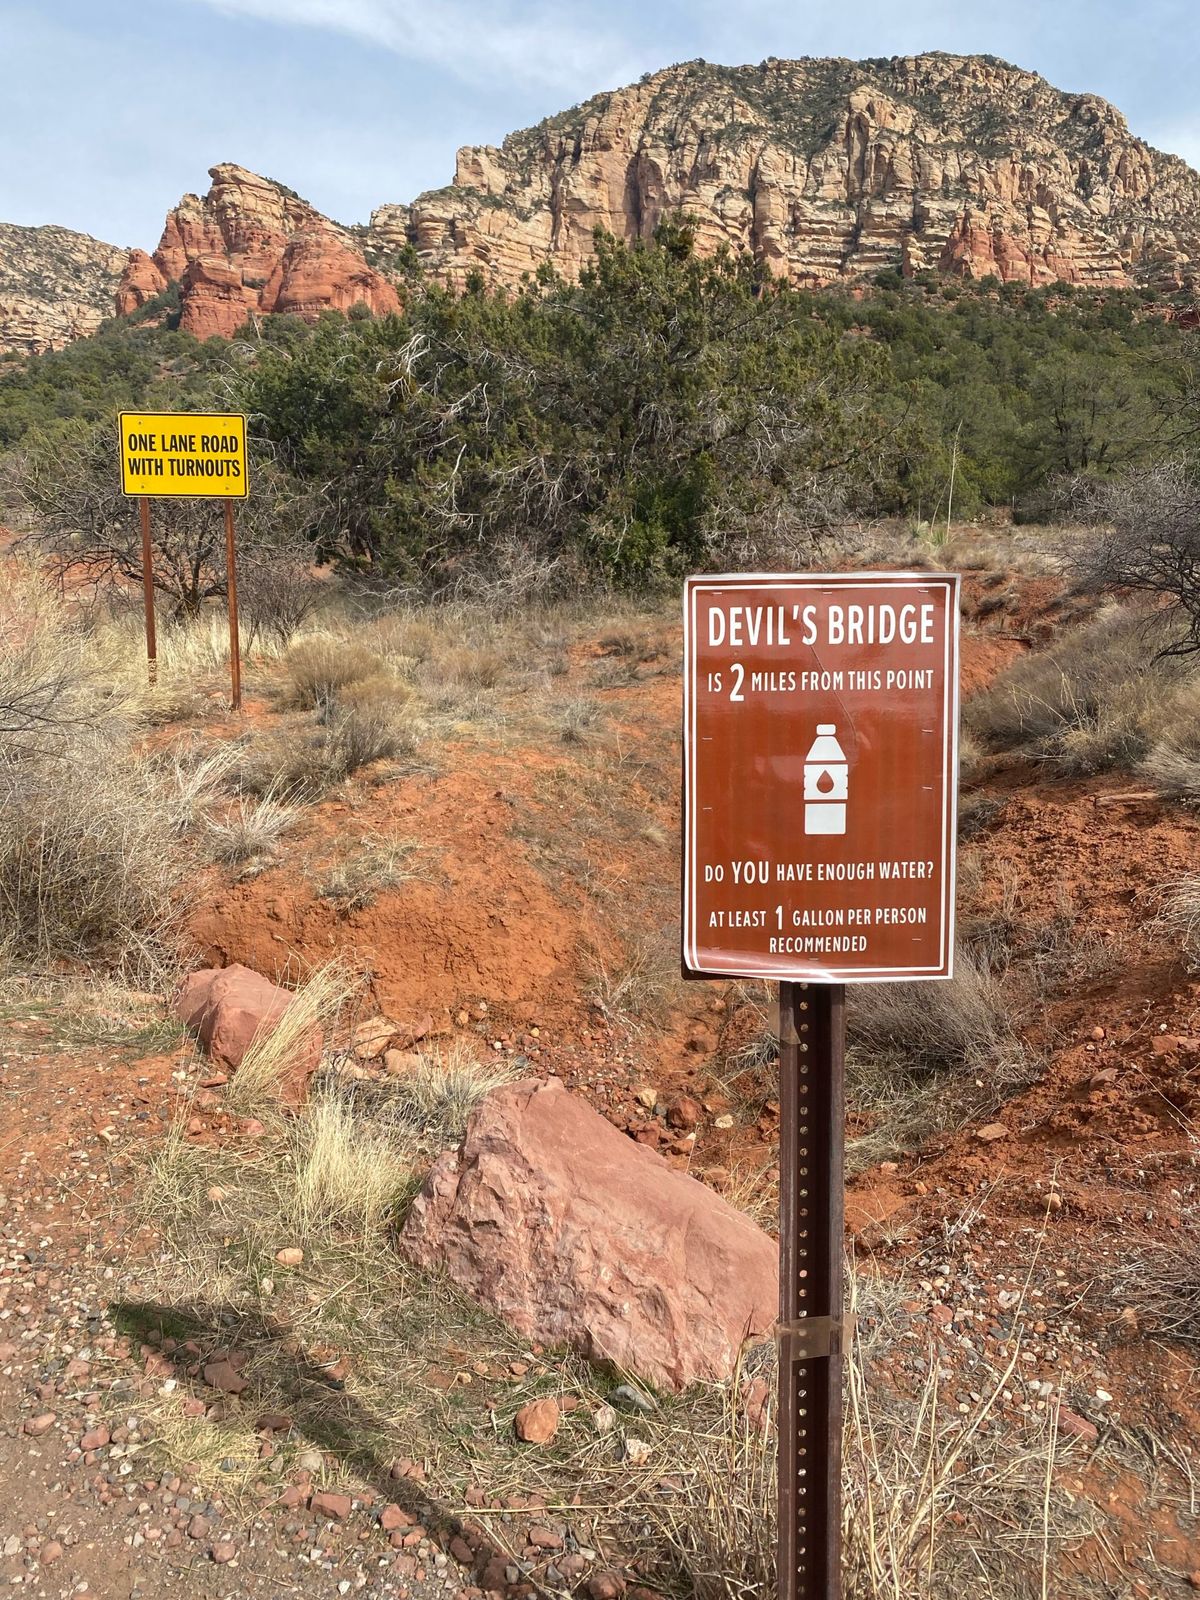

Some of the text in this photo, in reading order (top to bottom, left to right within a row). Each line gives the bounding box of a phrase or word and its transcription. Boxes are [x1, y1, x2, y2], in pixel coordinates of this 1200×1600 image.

[128, 434, 238, 453] ONE LANE ROAD
[128, 458, 240, 477] WITH TURNOUTS
[708, 604, 934, 646] DEVIL'S BRIDGE
[708, 663, 934, 702] IS 2 MILES FROM THIS POINT
[705, 861, 934, 884] DO YOU HAVE ENOUGH WATER?
[709, 905, 926, 930] AT LEAST 1 GALLON PER PERSON
[769, 936, 867, 953] RECOMMENDED
